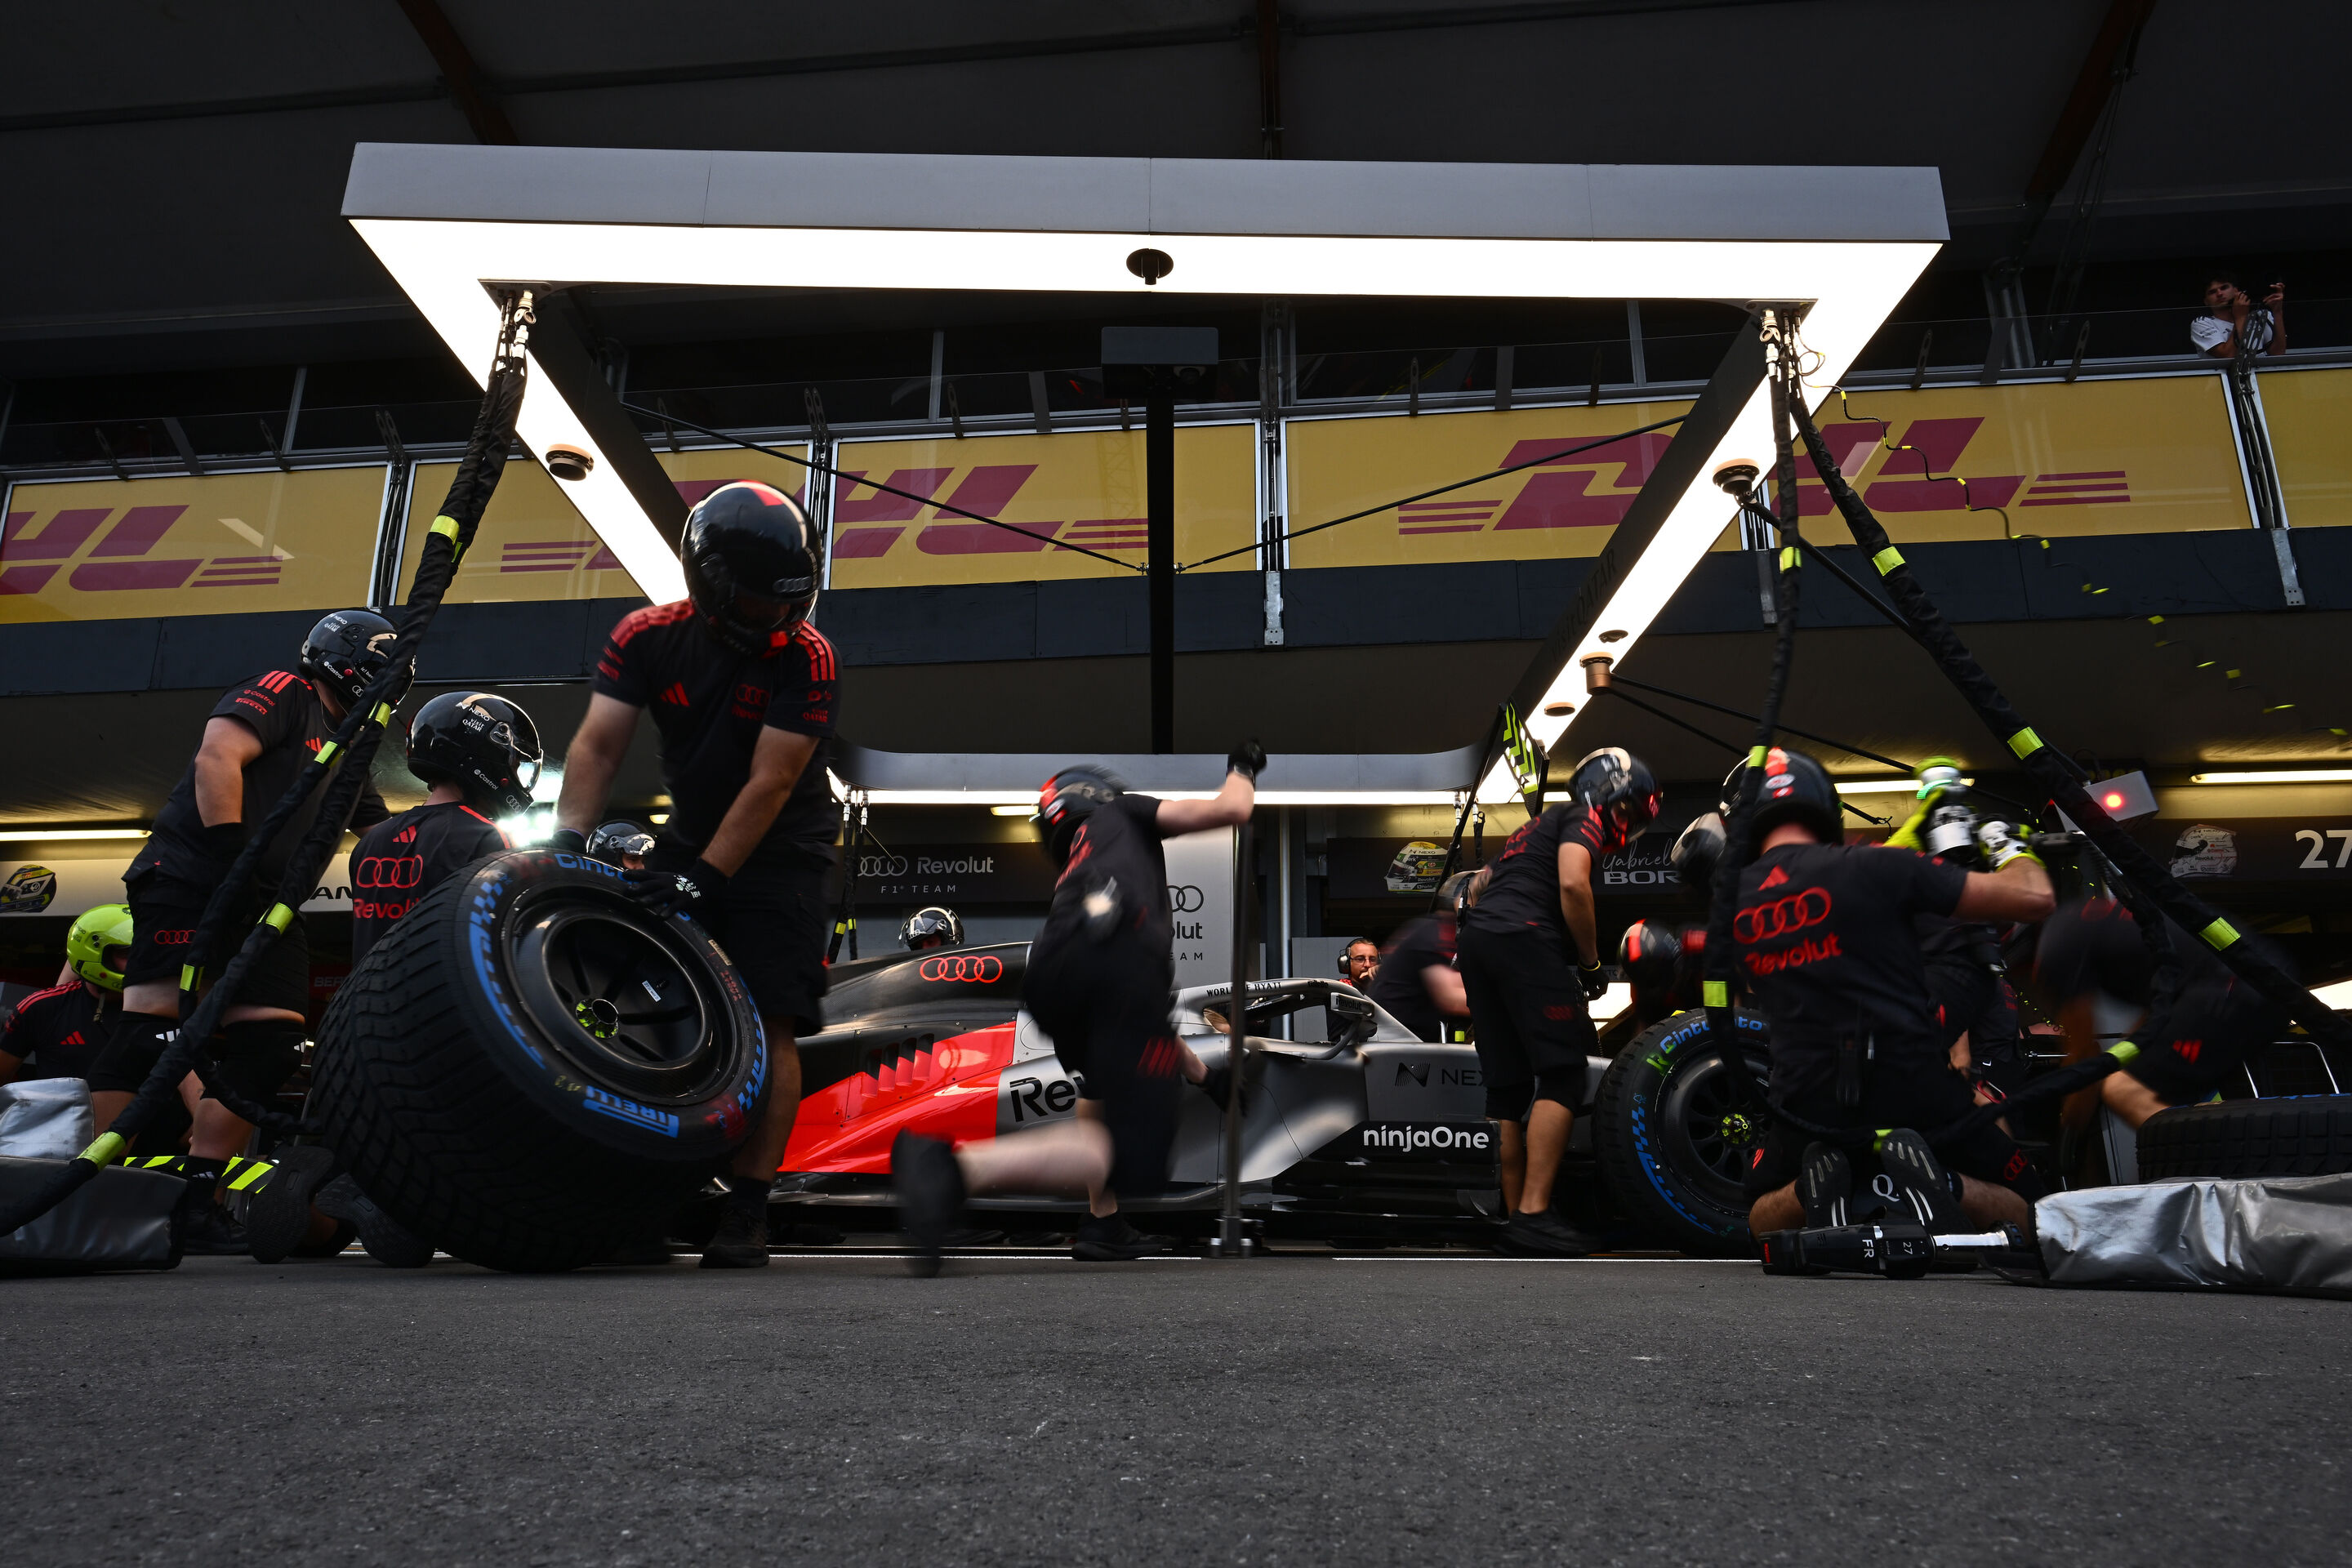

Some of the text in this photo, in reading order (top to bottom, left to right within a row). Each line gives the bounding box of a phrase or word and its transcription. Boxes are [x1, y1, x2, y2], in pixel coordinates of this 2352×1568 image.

[1576, 548, 1617, 626] QATAR
[327, 666, 345, 680] Castrol
[251, 690, 276, 706] Castrol
[468, 706, 491, 722] NEXO
[462, 719, 483, 733] QATAR
[479, 773, 500, 791] Castrol
[1602, 838, 1673, 877] Gabriel
[2295, 829, 2352, 869] 27
[916, 856, 994, 874] Revolut
[912, 884, 956, 893] TEAM
[1744, 932, 1842, 976] Revolut
[1206, 987, 1233, 997] WORL
[1254, 982, 1282, 991] HYATT
[581, 1085, 680, 1139] PIRELLI
[1363, 1125, 1490, 1152] ninjaOne
[1862, 1239, 1875, 1258] FR
[1902, 1241, 1913, 1255] 27
